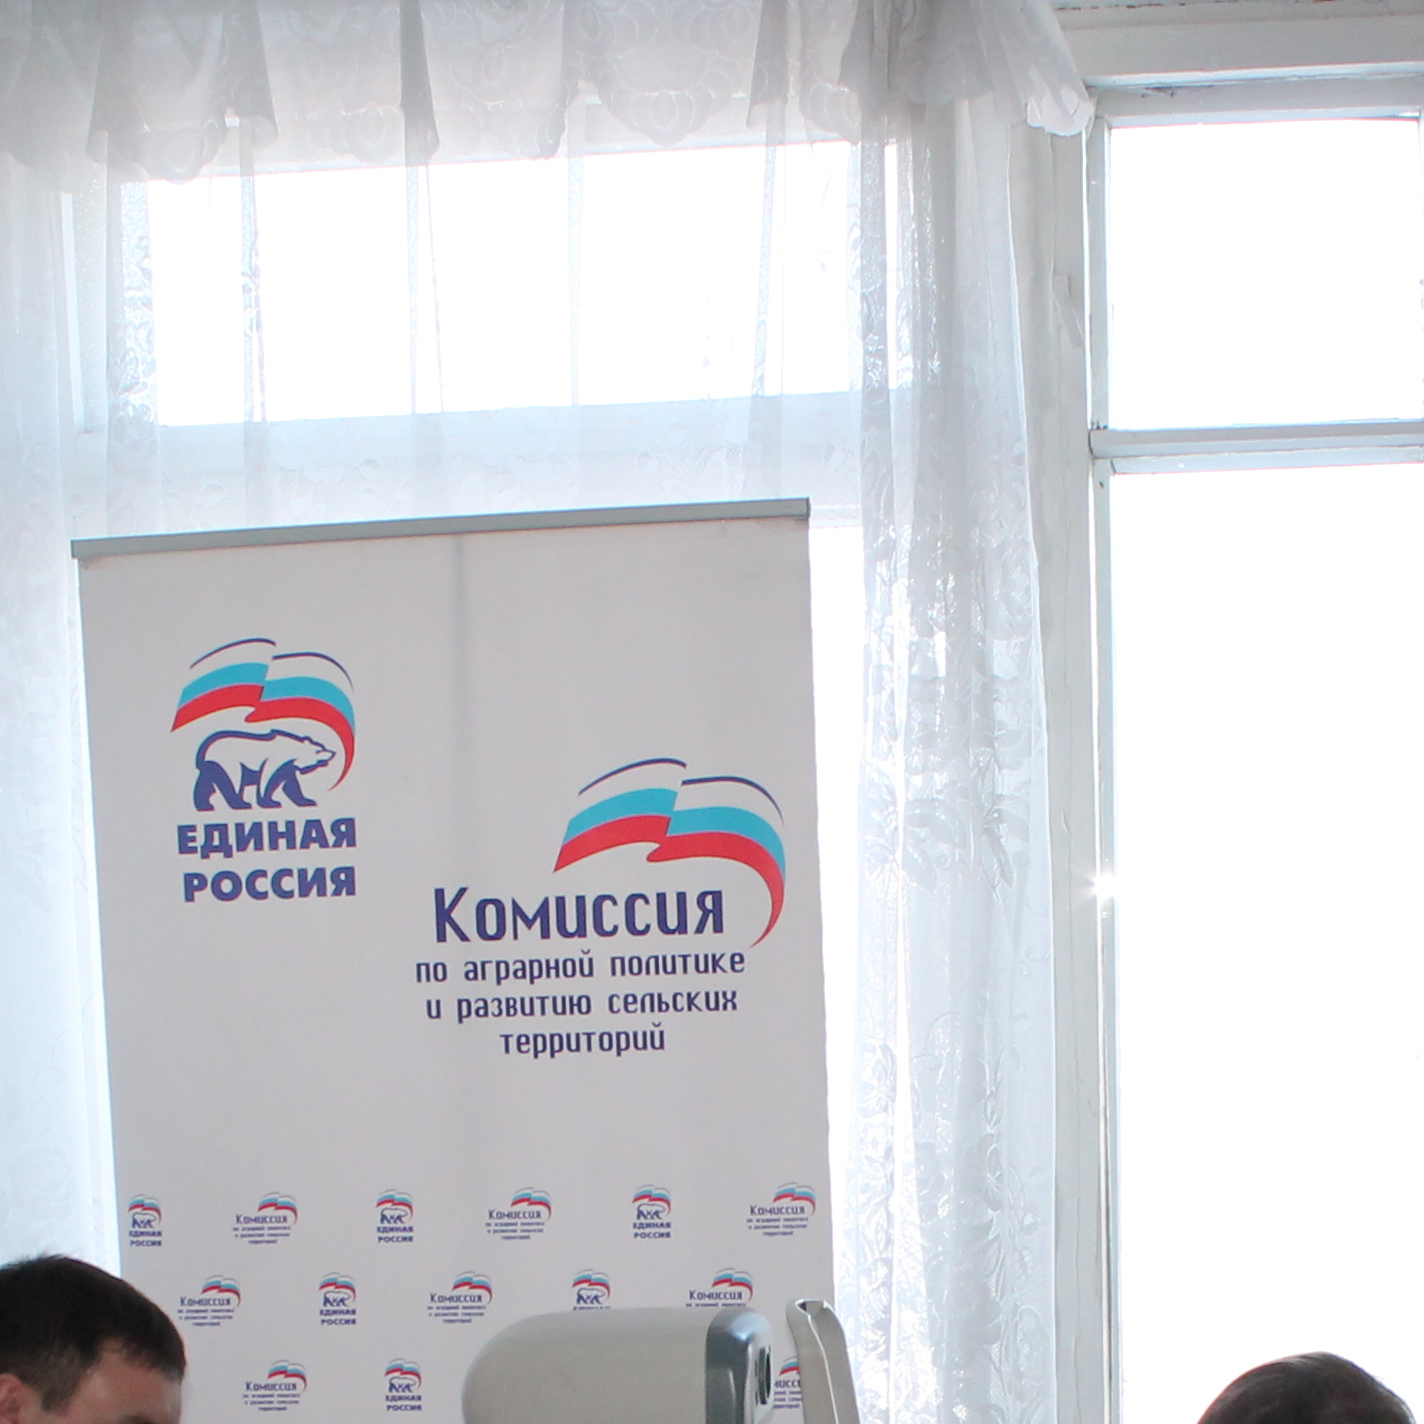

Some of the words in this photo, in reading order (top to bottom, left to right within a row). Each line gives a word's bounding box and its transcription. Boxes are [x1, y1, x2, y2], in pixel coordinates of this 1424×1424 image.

[178, 818, 356, 859] ЕДИНАЯ
[184, 866, 356, 902] РОССИЯ
[435, 887, 723, 943] Комиссия
[416, 962, 447, 982] по
[464, 950, 593, 985] аграрной
[611, 953, 744, 976] политике
[427, 1000, 441, 1019] и
[457, 995, 591, 1024] развитию
[609, 991, 737, 1014] сельских
[500, 1023, 664, 1059] территорий
[488, 1210, 541, 1220] Комиссия
[749, 1205, 804, 1216] Комиссия
[235, 1215, 287, 1225] Комиссия
[376, 1226, 413, 1234] ЕДИНАЯ
[632, 1222, 671, 1230] ЕДИНАЯ
[430, 1293, 482, 1304] Комиссия
[689, 1290, 742, 1301] Комиссия
[179, 1297, 231, 1307] Комиссия
[319, 1309, 356, 1317] ЕДИНАЯ
[245, 1381, 296, 1392] Комиссия
[385, 1395, 421, 1403] ЕДИНАЯ
